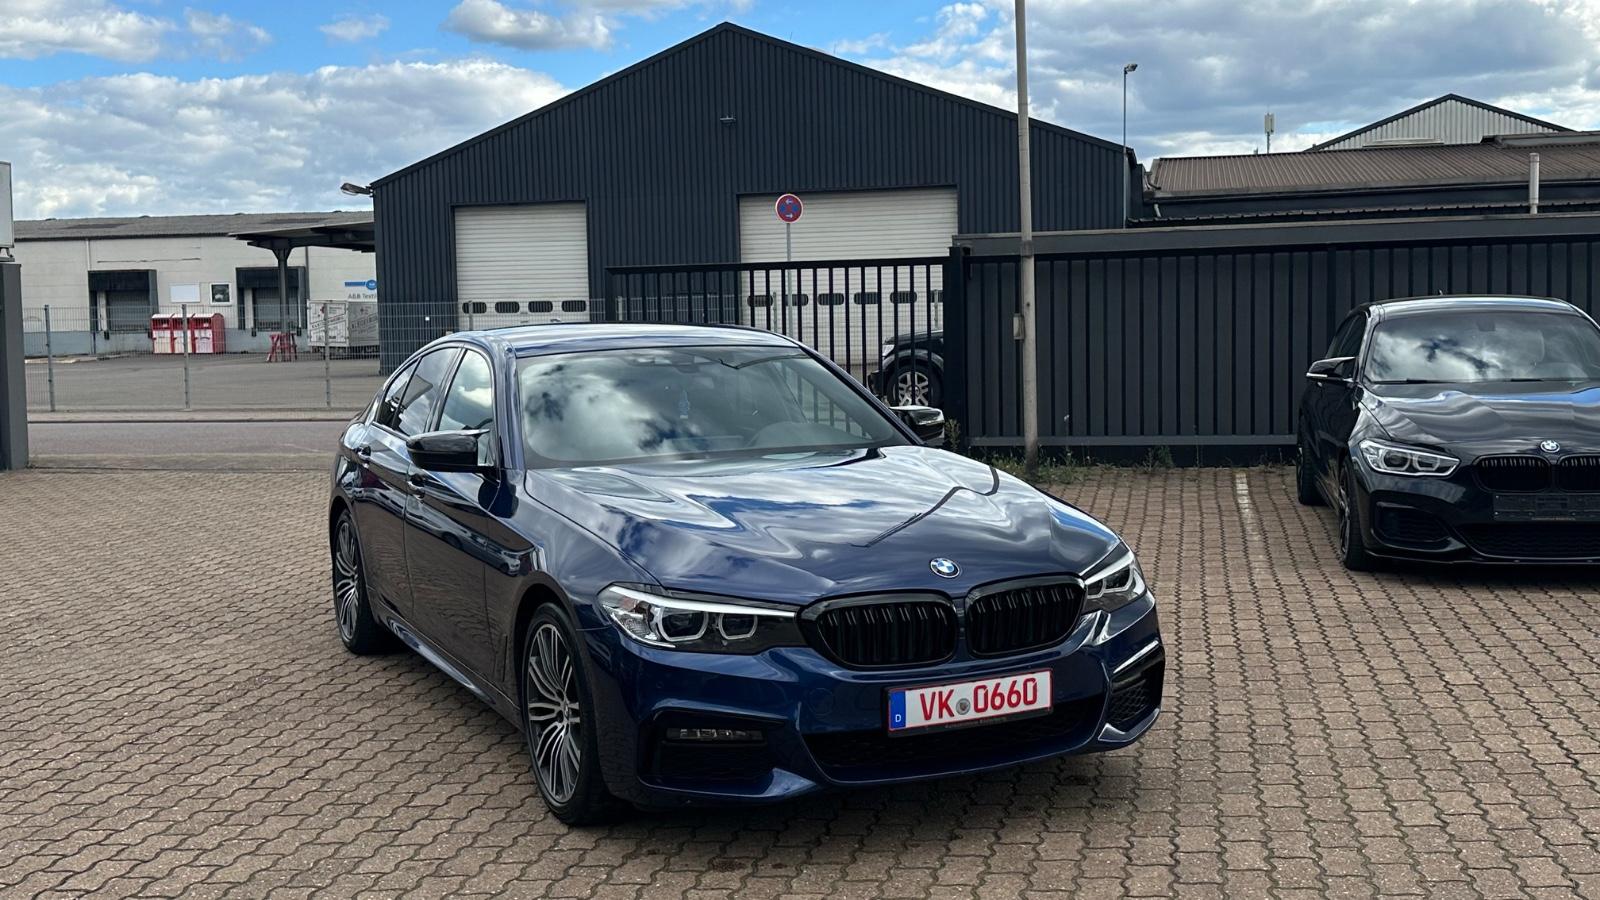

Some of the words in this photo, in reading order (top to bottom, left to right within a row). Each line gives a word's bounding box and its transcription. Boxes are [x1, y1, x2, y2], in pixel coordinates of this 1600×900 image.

[920, 689, 954, 721] VK
[973, 677, 1038, 713] 0660
[895, 714, 902, 723] D
